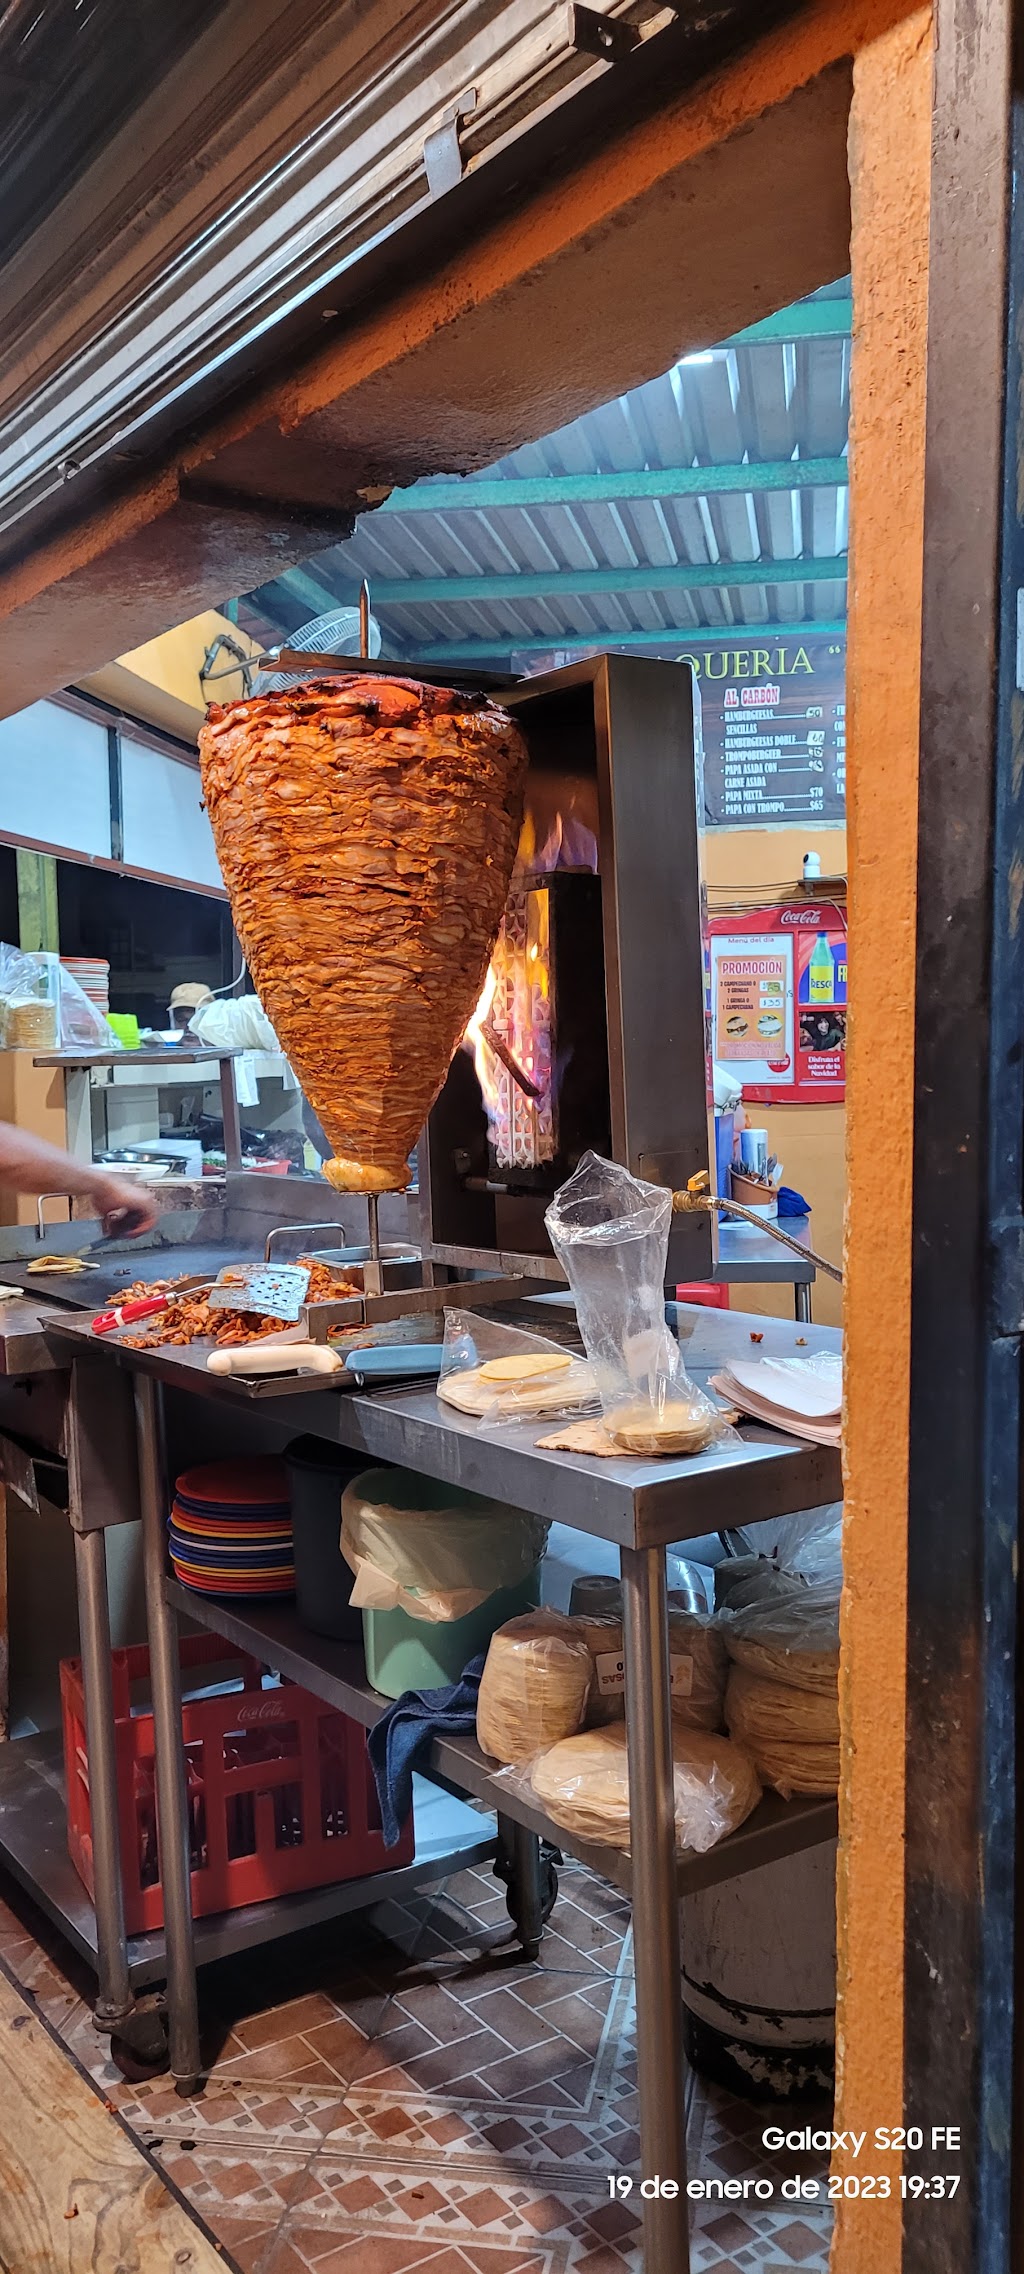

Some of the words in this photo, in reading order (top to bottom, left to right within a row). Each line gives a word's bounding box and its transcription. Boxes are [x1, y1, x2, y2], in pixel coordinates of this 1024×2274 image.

[725, 689, 738, 705] AL
[726, 723, 758, 735] SENCILLAS
[775, 735, 797, 746] DOBLE
[725, 764, 742, 775] PAPA
[743, 763, 764, 774] ASADA
[764, 762, 778, 773] CON
[725, 777, 745, 788] CARNE
[746, 776, 767, 787] ASADA
[725, 791, 742, 802] PAPA
[743, 790, 763, 801] MIXTA
[725, 804, 742, 815] PAPA
[743, 803, 756, 814] CON
[757, 802, 785, 814] TROMPO
[781, 909, 822, 924] Coca-Cola
[722, 958, 782, 974] PROMOCIÓN
[237, 1700, 282, 1721] Coca-Cola
